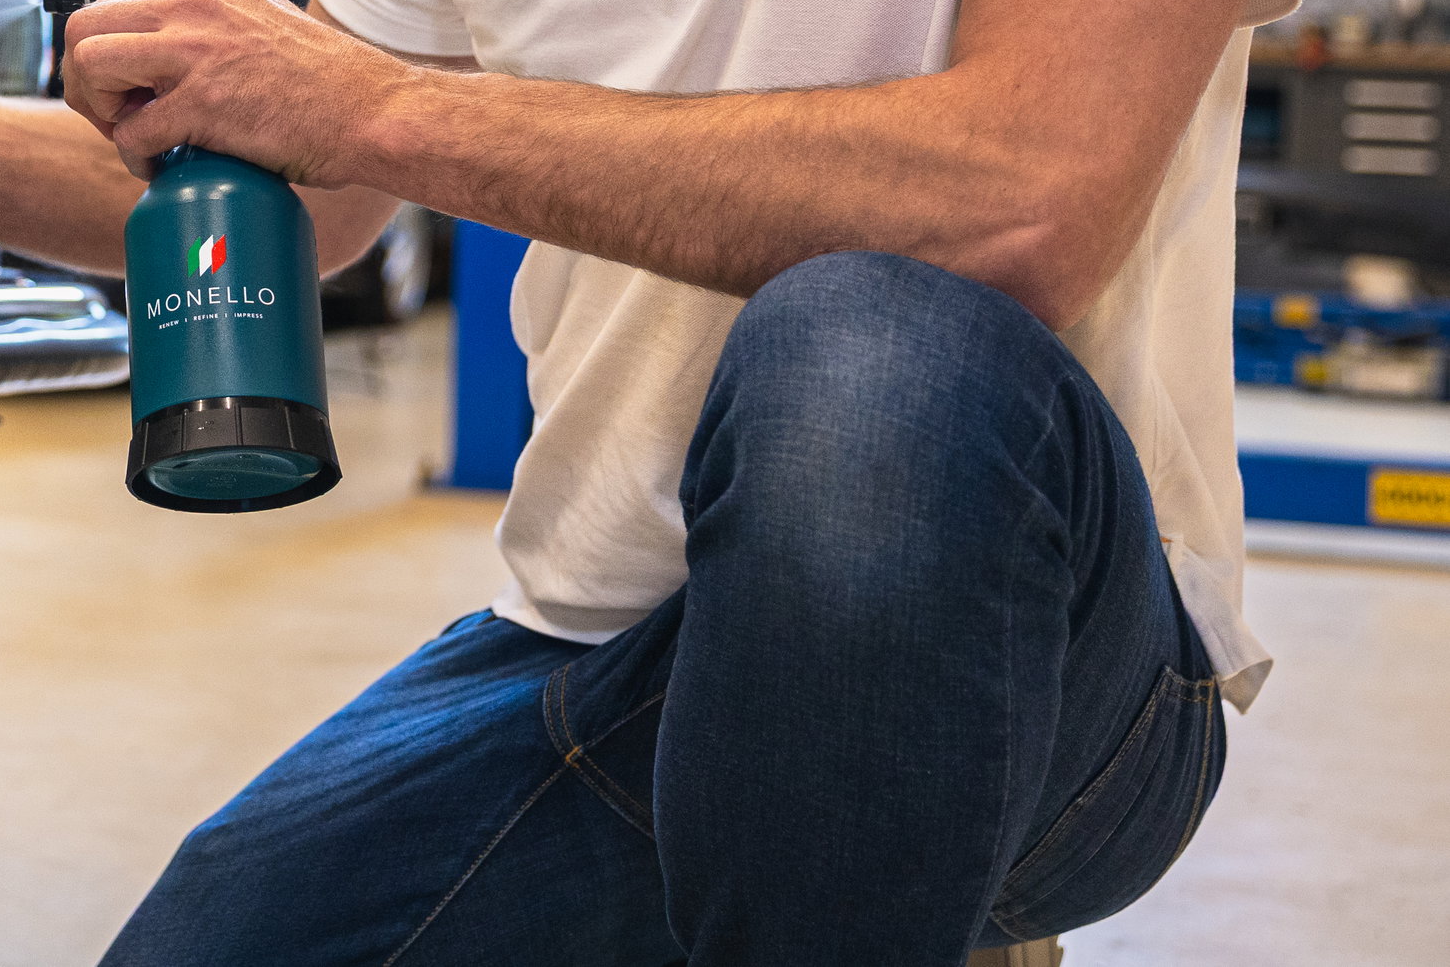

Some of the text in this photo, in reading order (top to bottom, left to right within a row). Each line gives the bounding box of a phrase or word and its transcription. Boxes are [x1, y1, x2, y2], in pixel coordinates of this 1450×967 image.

[147, 286, 275, 319] MONELLO
[158, 319, 180, 330] RENEW
[193, 313, 219, 321] REFINE
